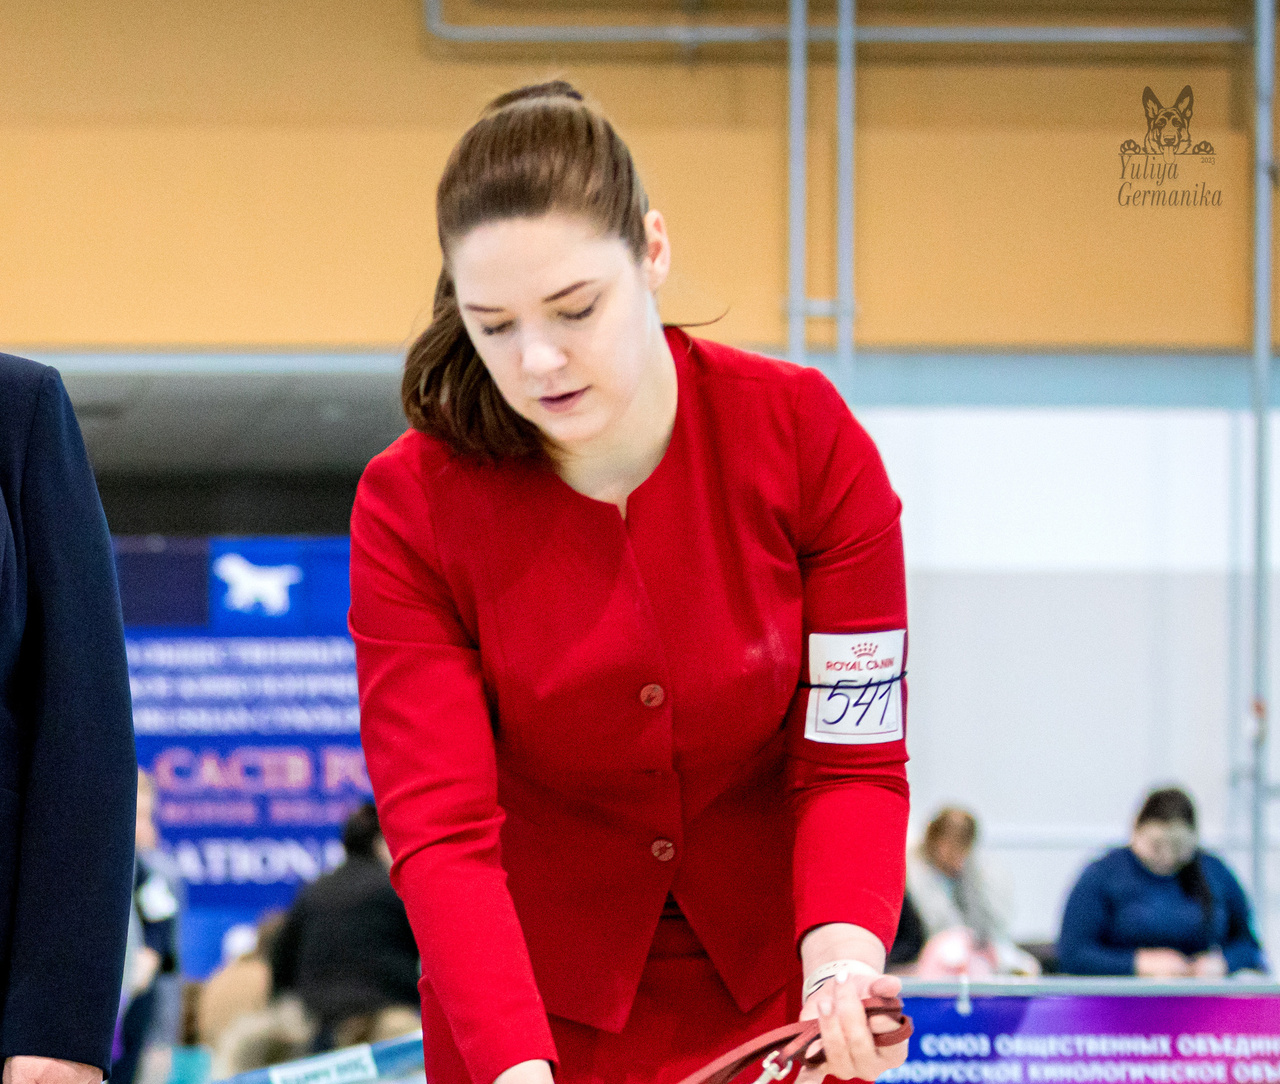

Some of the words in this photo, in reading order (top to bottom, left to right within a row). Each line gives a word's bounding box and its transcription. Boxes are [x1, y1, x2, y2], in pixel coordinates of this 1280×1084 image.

[826, 660, 863, 671] ROYAL
[822, 674, 894, 727] 541
[921, 1034, 991, 1057] СОЮЗ
[995, 1034, 1171, 1057] ОБЩЕСТВЕННЫХ
[1028, 1061, 1228, 1083] КИНОЛОГИЧЕСКОЕ
